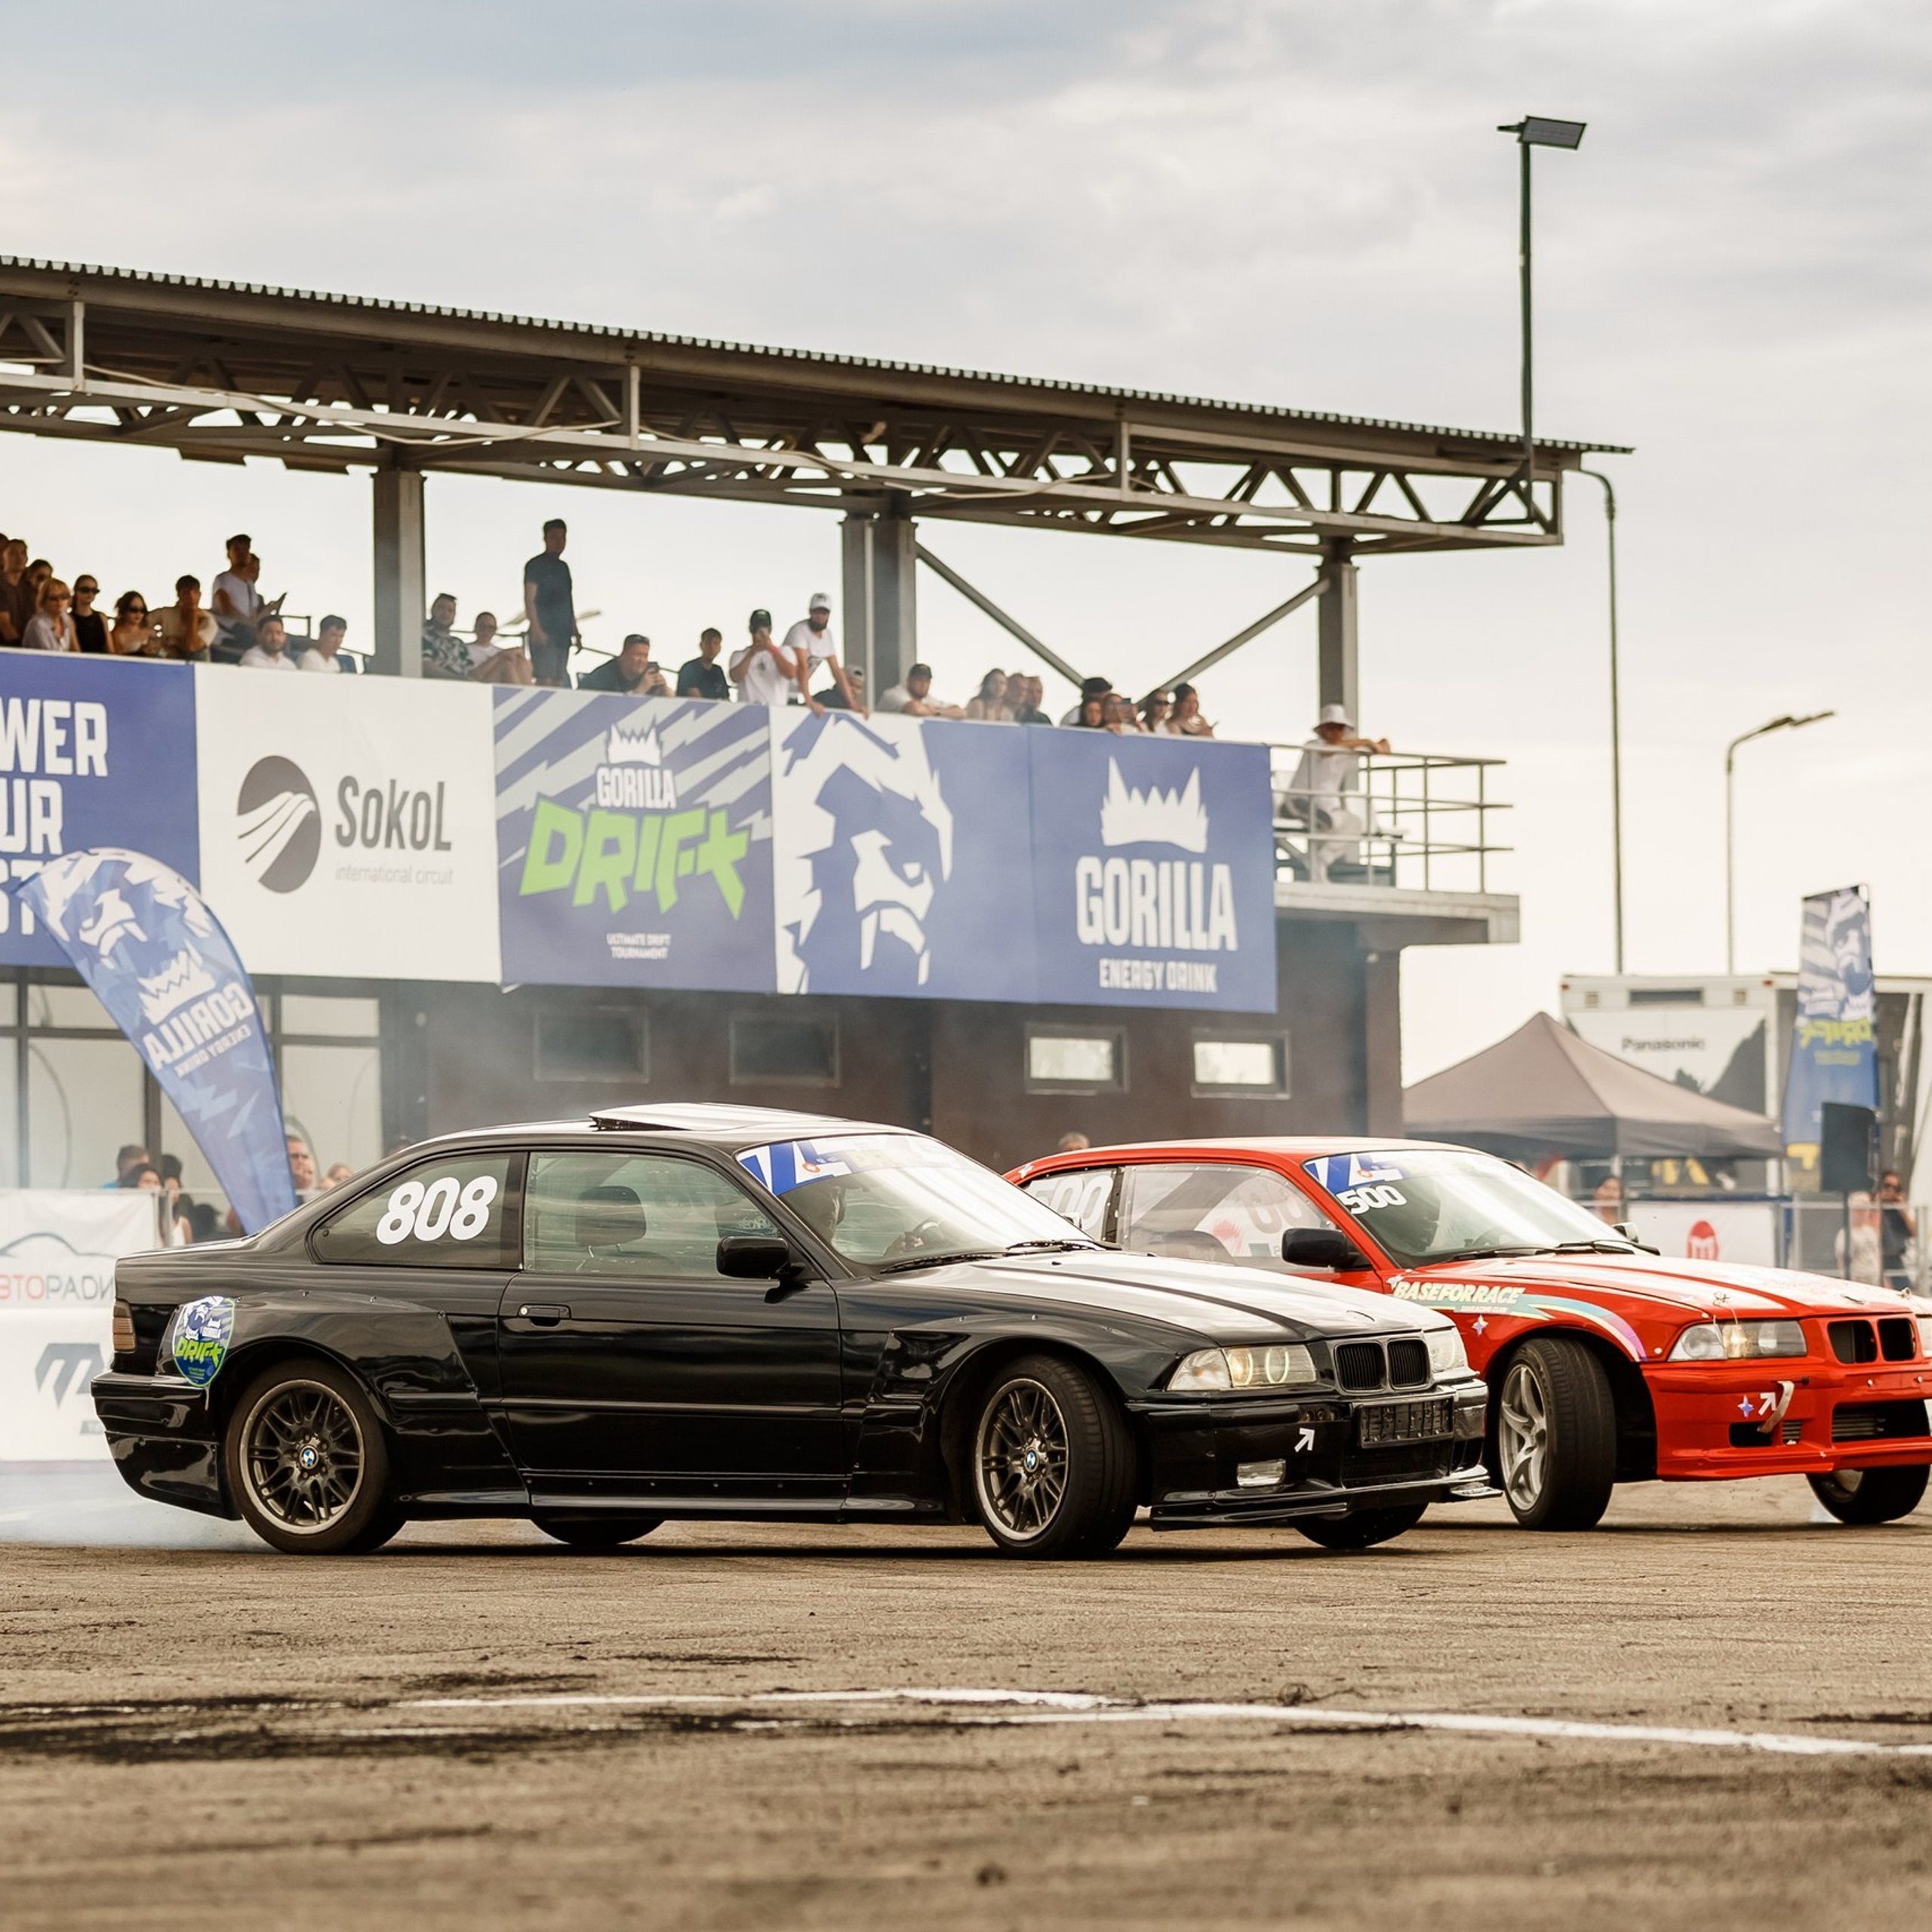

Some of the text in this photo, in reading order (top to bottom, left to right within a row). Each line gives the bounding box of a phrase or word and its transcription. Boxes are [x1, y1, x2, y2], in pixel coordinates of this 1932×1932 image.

[596, 766, 676, 810] GORILLA
[519, 799, 750, 921] DRIFT
[1075, 856, 1238, 951] GORILLA
[1099, 958, 1217, 993] ENERGY DRINK
[1622, 1037, 1705, 1052] Panasonic
[377, 1176, 498, 1244] 808
[1336, 1185, 1407, 1214] 500
[1393, 1281, 1525, 1304] BASEFORRACE
[175, 1336, 223, 1368] DRIFT
